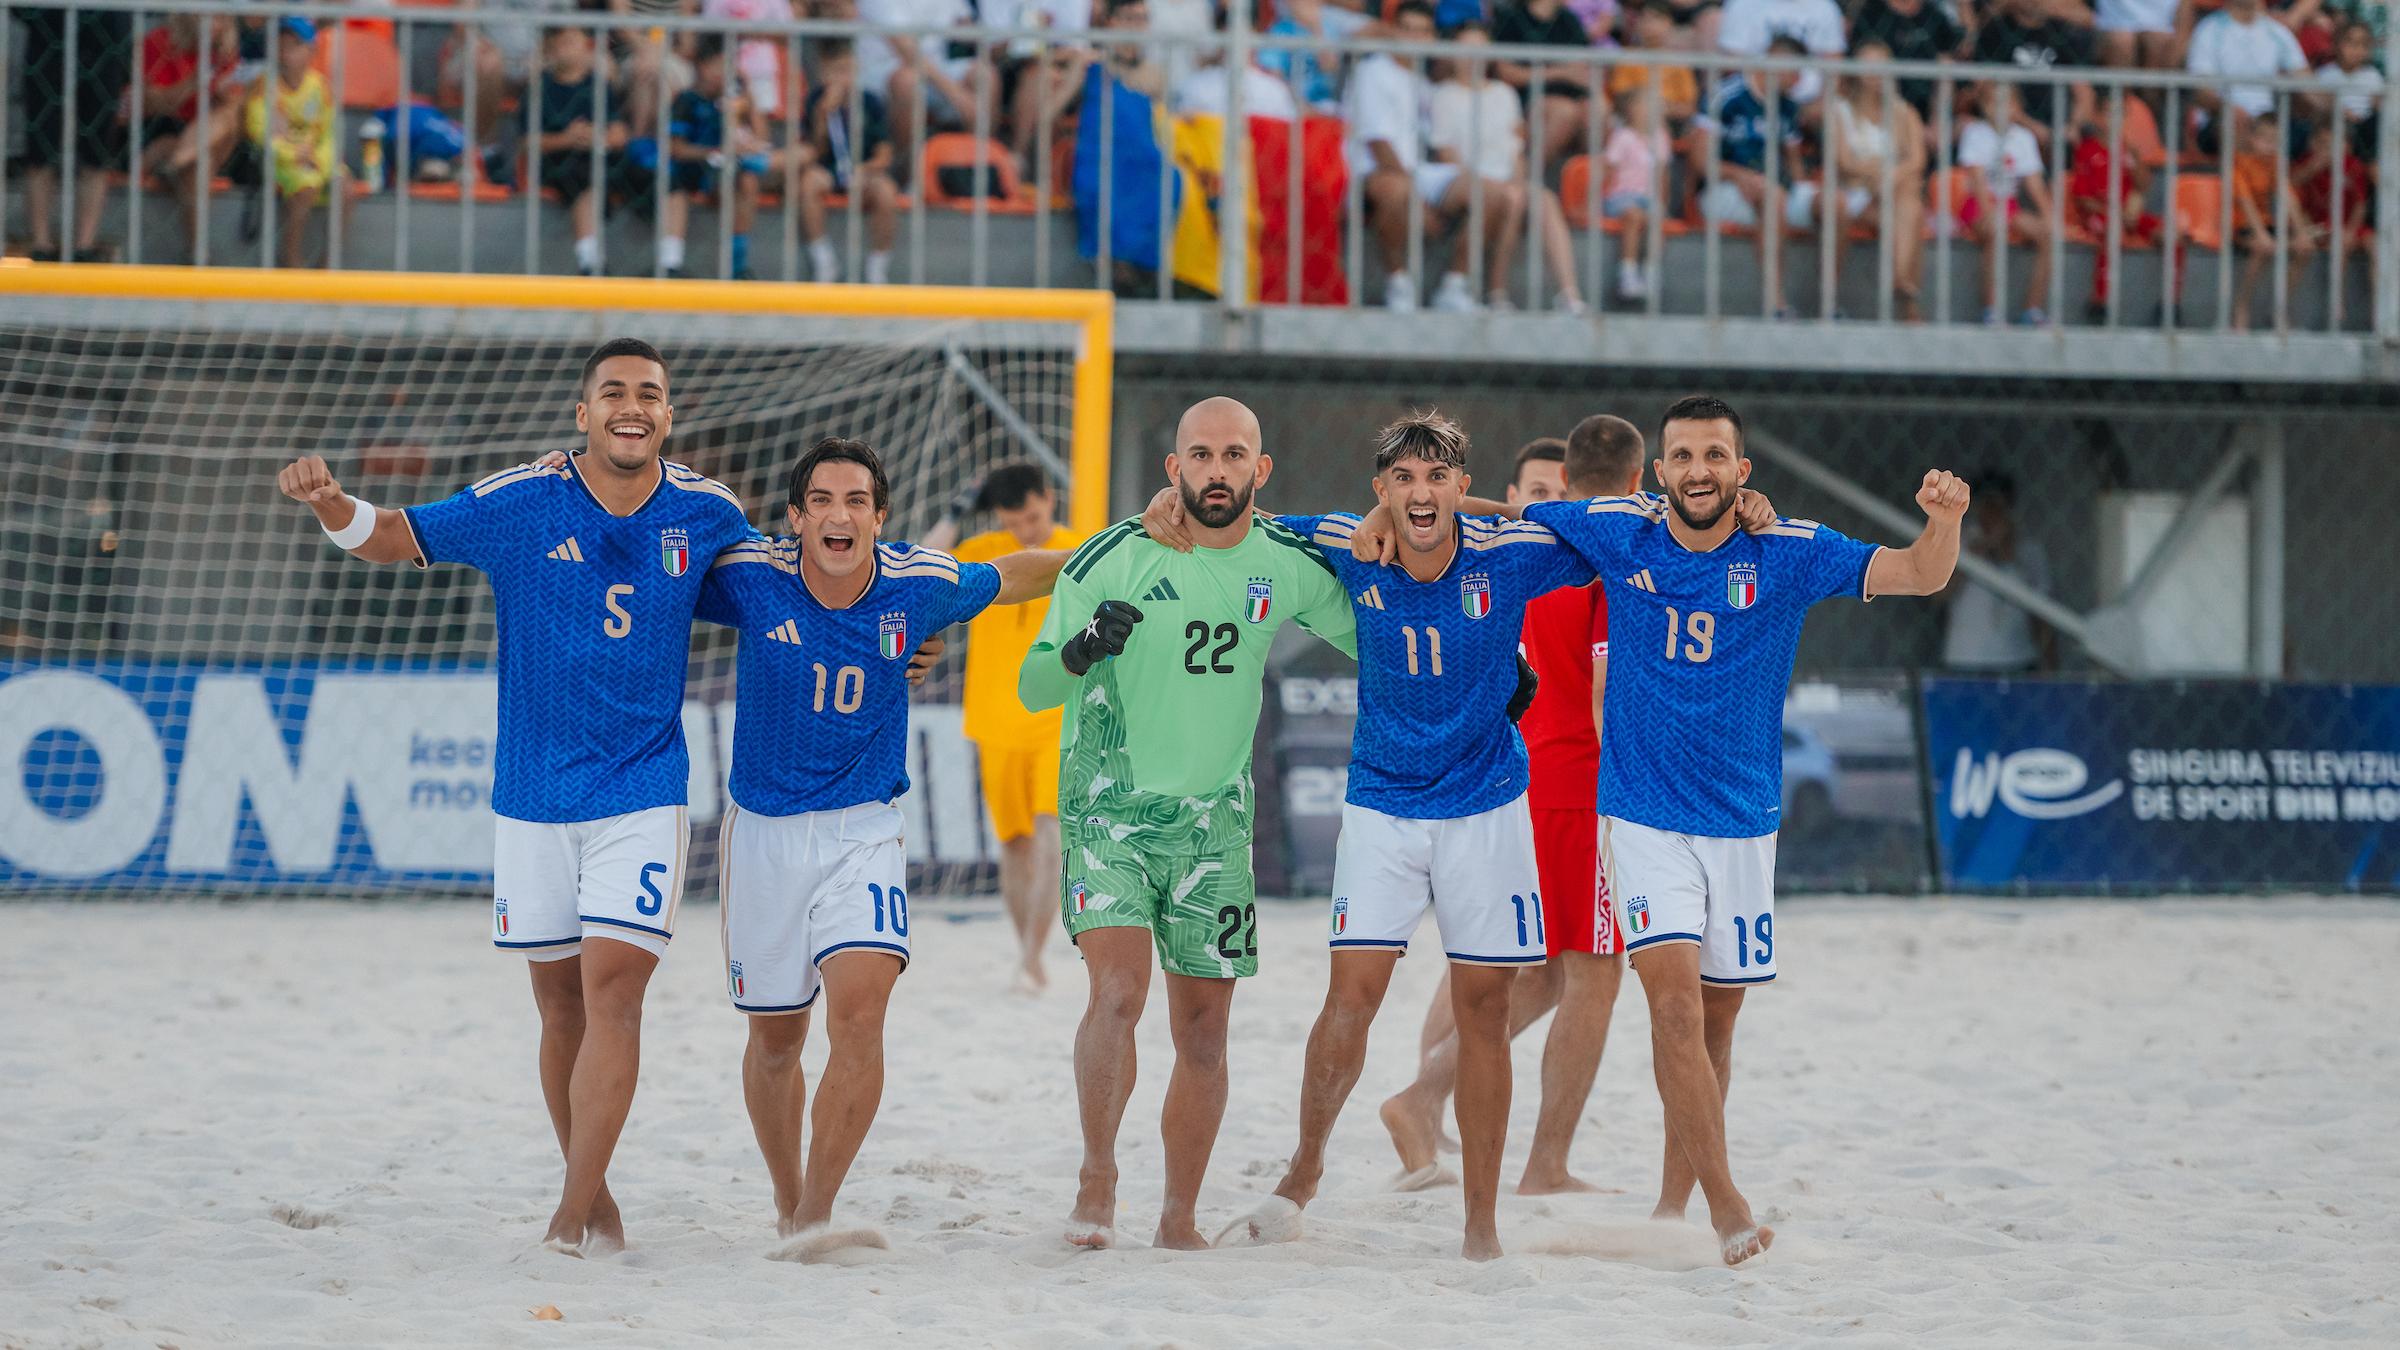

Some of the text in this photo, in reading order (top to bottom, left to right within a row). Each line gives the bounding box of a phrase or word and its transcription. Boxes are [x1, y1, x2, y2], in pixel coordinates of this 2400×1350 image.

[664, 539, 686, 547] ITALIA
[1249, 586, 1270, 596] ITALIA
[1463, 582, 1488, 591] ITALIA
[1730, 573, 1754, 581] ITALIA
[604, 584, 635, 638] 5
[881, 622, 904, 632] ITALIA
[1665, 606, 1715, 662] 19
[1185, 620, 1239, 674] 22
[1401, 625, 1443, 676] 11
[812, 662, 865, 713] 10
[2128, 748, 2270, 785] SINGURA
[2131, 785, 2174, 820] DE
[2176, 785, 2270, 820] SPORT
[2274, 786, 2339, 821] DIN
[636, 862, 667, 917] 5
[868, 883, 908, 938] 10
[1218, 903, 1257, 958] 22
[1511, 892, 1544, 946] 11
[1733, 912, 1773, 967] 19
